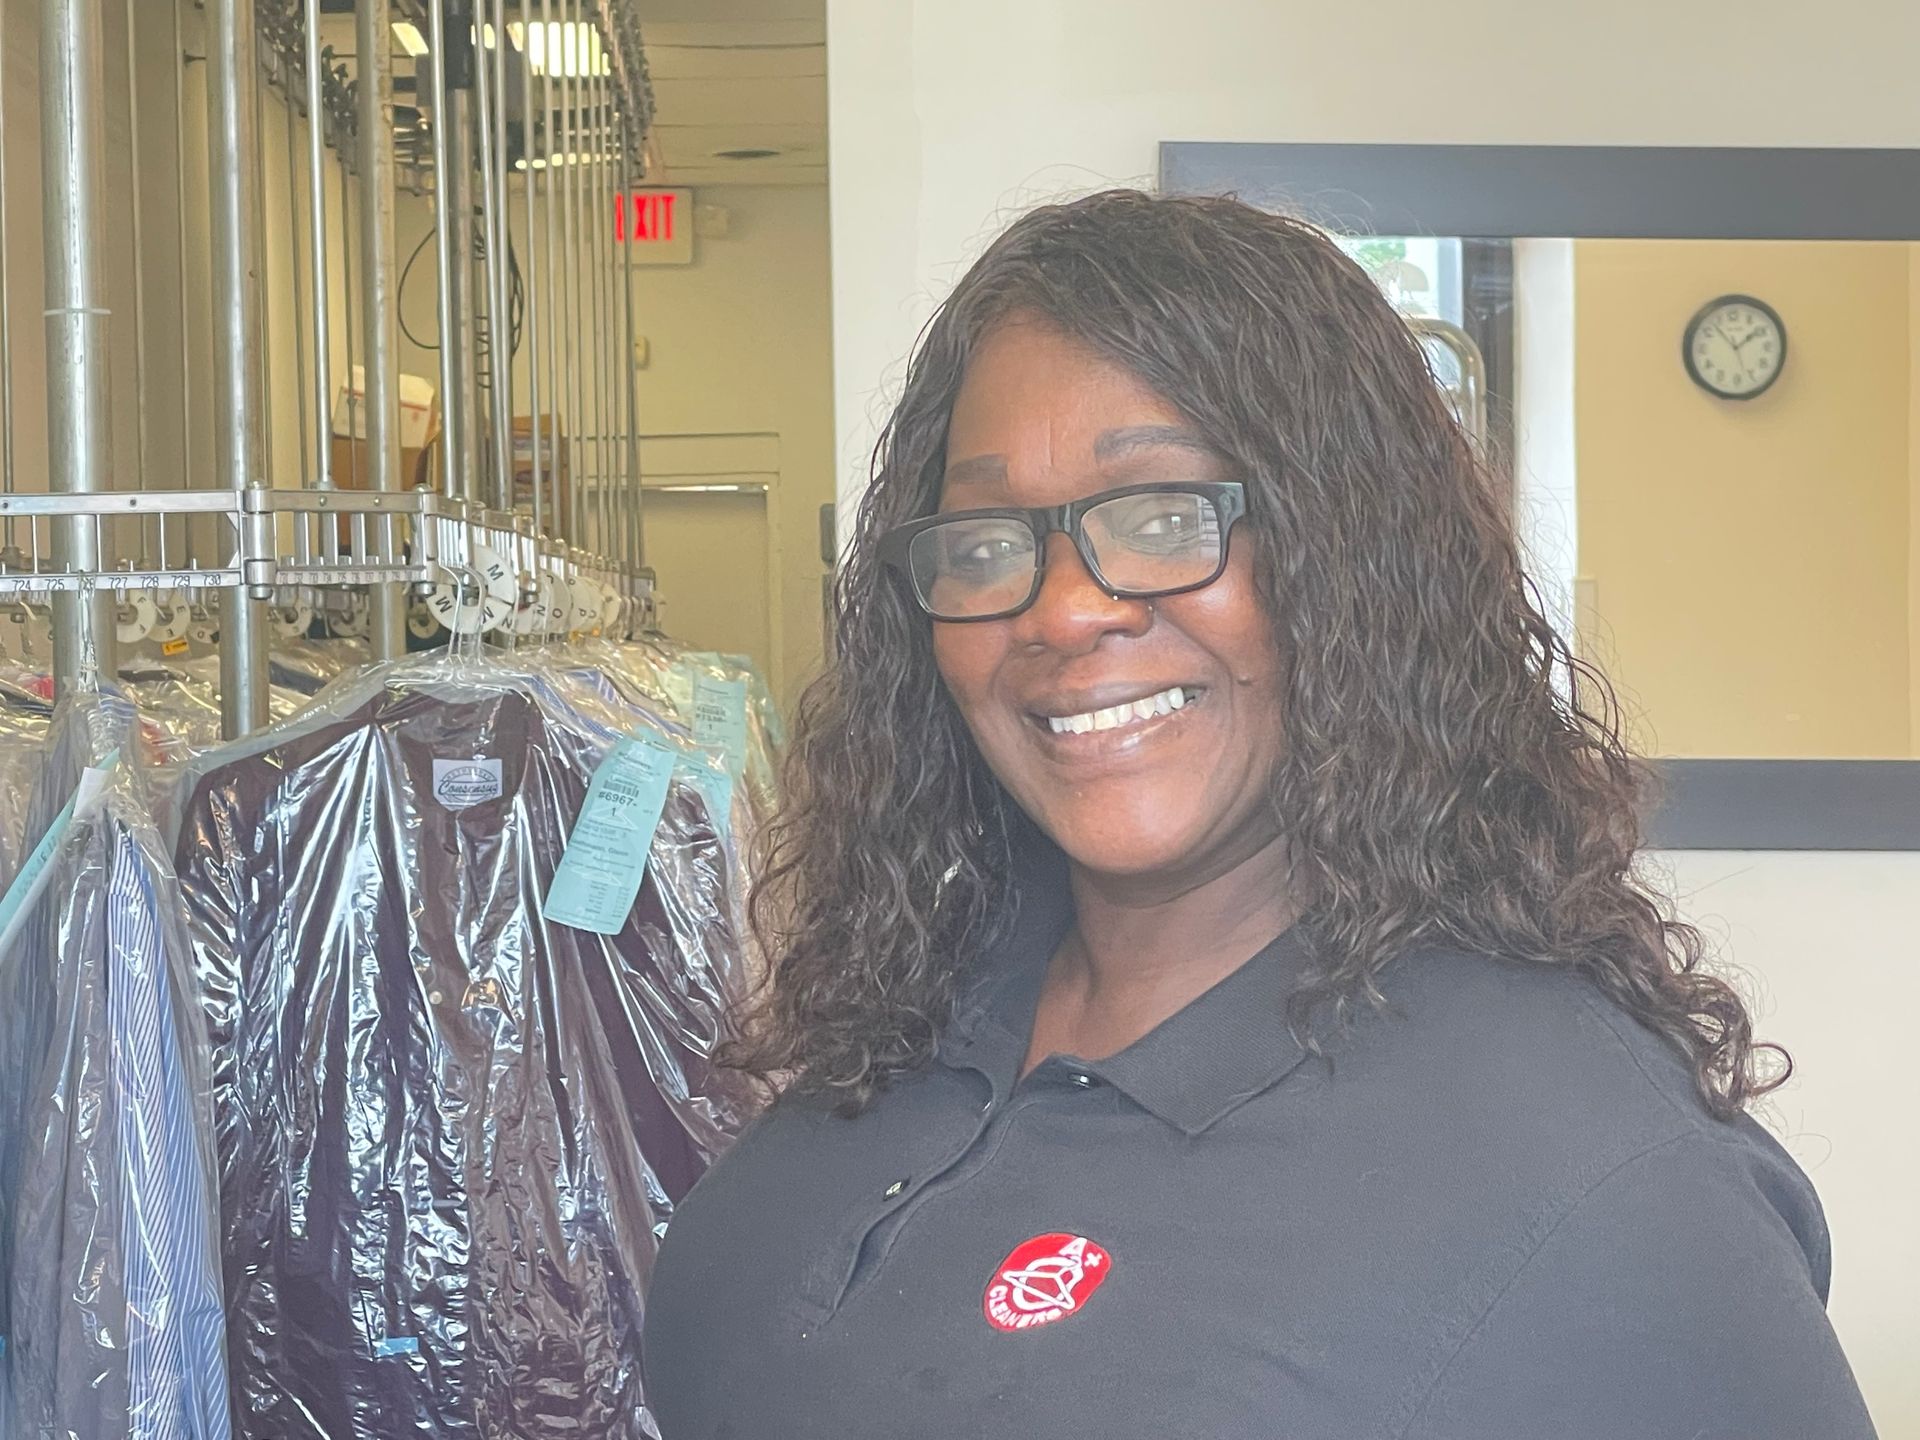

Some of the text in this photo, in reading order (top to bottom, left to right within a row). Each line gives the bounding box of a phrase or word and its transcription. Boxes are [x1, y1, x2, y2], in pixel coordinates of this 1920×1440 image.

[487, 563, 504, 581] M
[12, 579, 31, 591] 724
[44, 578, 65, 590] 725
[109, 576, 128, 589] 727
[139, 575, 160, 588] 728
[171, 575, 191, 587] 729
[203, 573, 222, 587] 730
[435, 596, 453, 614] M
[598, 790, 637, 807] #6967-
[612, 807, 617, 817] 1
[989, 1285, 1063, 1328] CLEANERS
